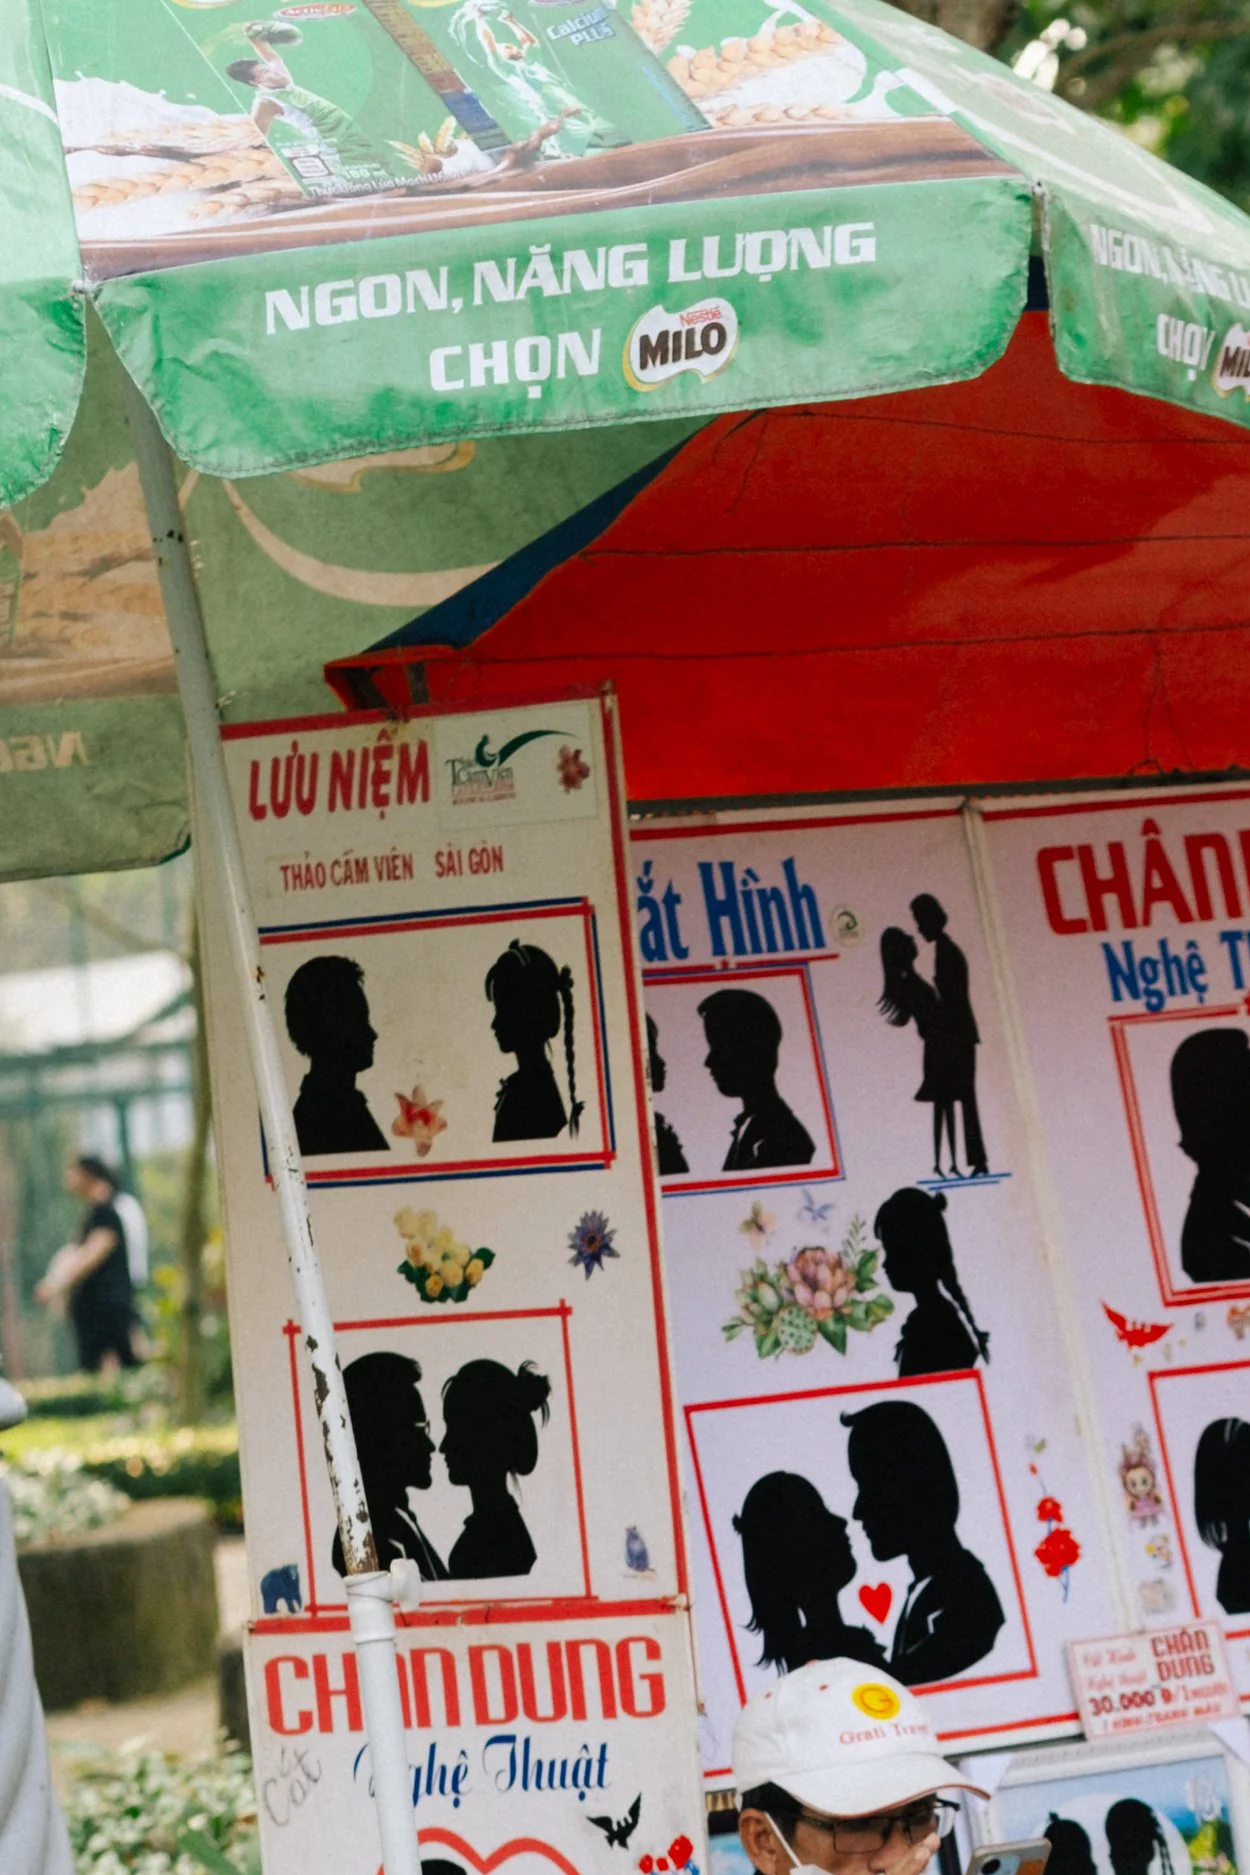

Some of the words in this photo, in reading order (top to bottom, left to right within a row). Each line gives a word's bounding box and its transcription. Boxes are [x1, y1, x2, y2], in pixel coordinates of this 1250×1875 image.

[265, 266, 463, 335] NGON,
[472, 243, 648, 305] NĂNG
[668, 222, 876, 282] LƯỢNG
[430, 328, 602, 399] CHỌN
[640, 322, 727, 371] MILO
[249, 740, 319, 821] LƯU
[328, 728, 430, 820] NIỆM
[636, 860, 690, 963] ắt
[697, 856, 827, 957] Hình
[1102, 938, 1209, 1012] Nghệ
[1152, 1627, 1209, 1658] CHÂN
[1157, 1654, 1215, 1681] DUNG
[264, 1646, 461, 1736] CHN
[468, 1636, 667, 1726] DUNG
[482, 1734, 611, 1801] Thuật
